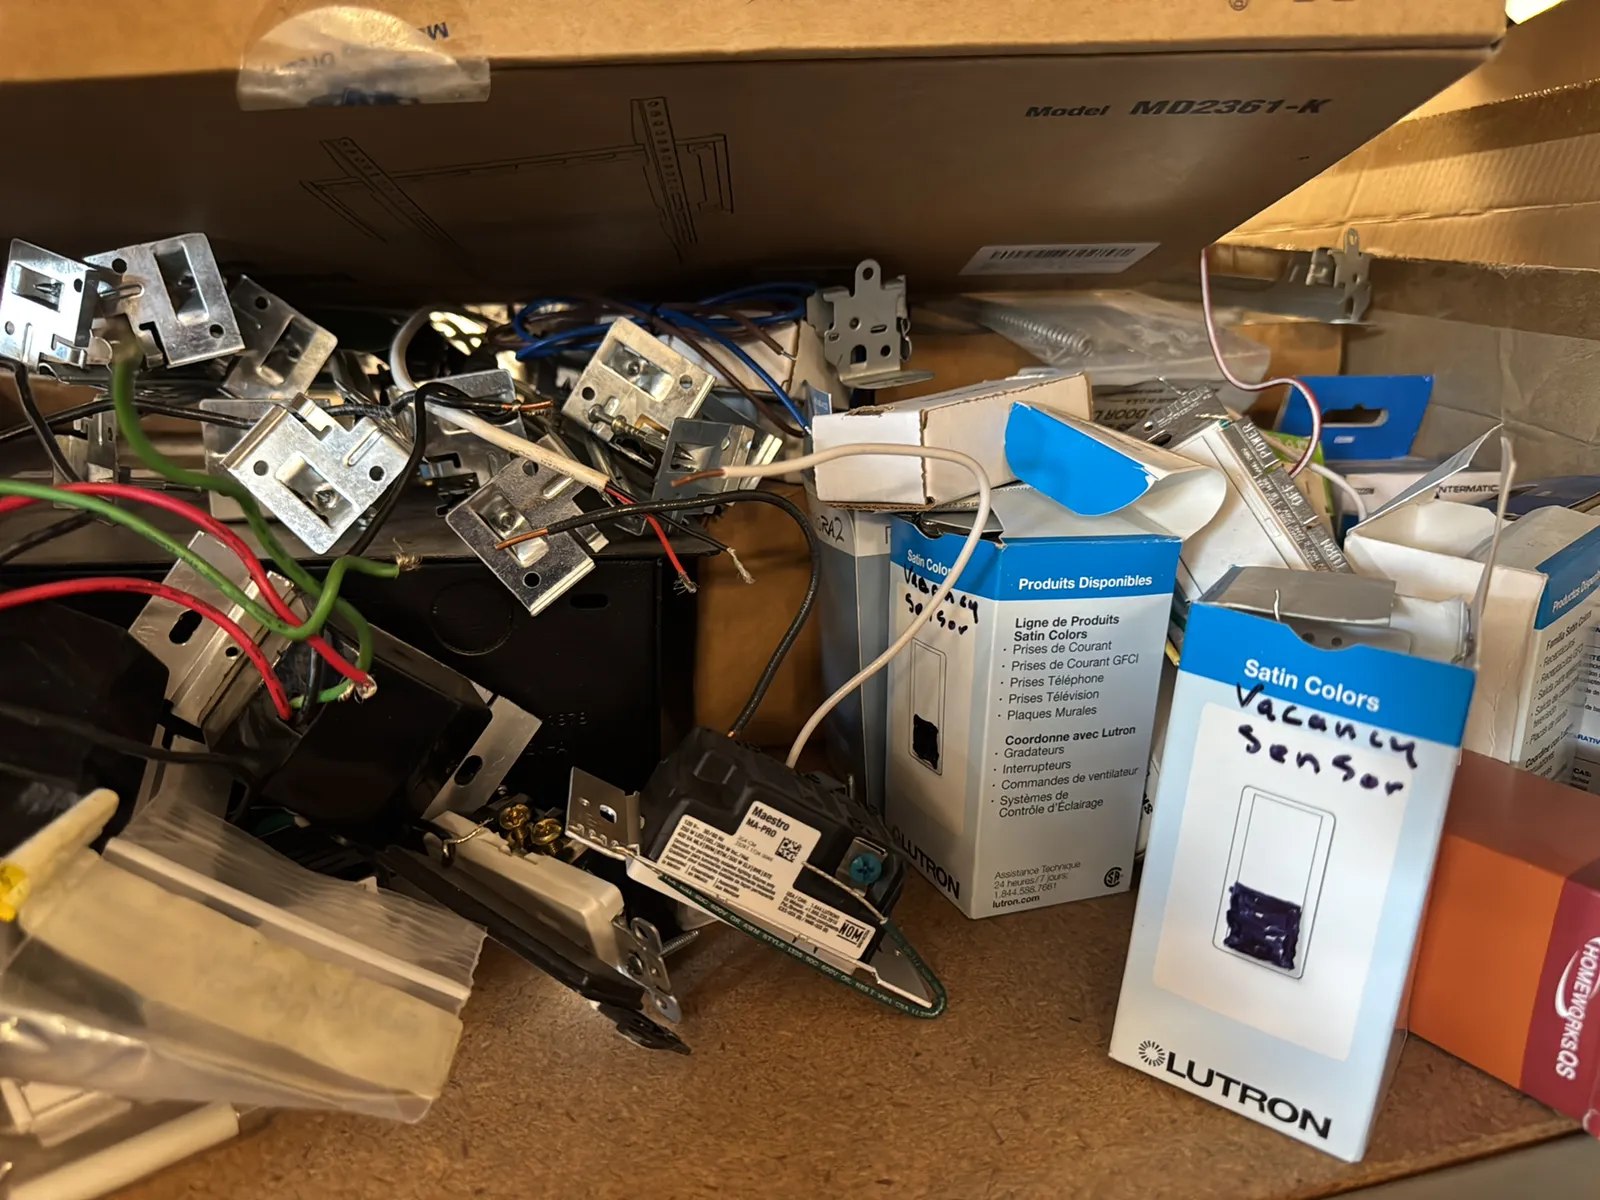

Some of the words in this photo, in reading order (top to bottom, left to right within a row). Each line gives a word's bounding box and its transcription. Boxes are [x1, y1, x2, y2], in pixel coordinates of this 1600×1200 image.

[1025, 105, 1111, 117] Model
[1130, 98, 1335, 115] MD2361-K
[1241, 421, 1272, 460] POWER
[1437, 484, 1500, 494] NTERMATIC
[907, 549, 925, 568] Satin
[926, 558, 953, 576] Colo
[1018, 577, 1075, 591] Produits
[1078, 575, 1153, 590] Disponibles
[1015, 617, 1048, 630] Ligne
[1052, 616, 1067, 627] de
[1071, 614, 1120, 627] Produits
[1014, 630, 1045, 642] Satin
[1048, 628, 1088, 641] Colors
[1013, 644, 1047, 655] Prises
[1051, 643, 1065, 653] de
[1068, 640, 1112, 652] Courant
[1011, 660, 1046, 671] Prises
[1050, 659, 1064, 670] de
[1067, 657, 1110, 669] Courant
[1113, 653, 1139, 665] GFCI
[1010, 676, 1045, 688] Prises
[1048, 672, 1104, 687] Téléphone
[1244, 658, 1298, 690] Satin
[1304, 676, 1380, 712] Colors
[1008, 693, 1043, 704] Prises
[1047, 689, 1100, 702] Télévision
[1007, 709, 1052, 722] Plaques
[1055, 705, 1097, 717] Murales
[1236, 682, 1417, 769] Vacancy
[1005, 732, 1070, 746] Coordonne
[1072, 731, 1099, 741] avec
[1102, 725, 1136, 738] Lutron
[1004, 745, 1065, 758] Gradateurs
[1003, 760, 1072, 774] Interrupteurs
[1001, 776, 1070, 790] Commandes
[1072, 773, 1086, 784] de
[1088, 766, 1139, 781] ventilateur
[1000, 793, 1053, 807] Systèmes
[1055, 790, 1069, 800] de
[752, 806, 790, 831] Maestro
[999, 803, 1045, 818] Contrôle
[746, 818, 777, 838] MA-PRO
[902, 833, 960, 900] LUTRON
[994, 867, 1040, 879] Assistance
[1041, 861, 1081, 873] Technique
[994, 881, 1005, 889] 24
[992, 895, 1040, 908] lutron.com
[839, 921, 863, 943] NOM
[1561, 943, 1600, 1051] HOMEWORKS
[1555, 1049, 1579, 1081] QS
[1165, 1051, 1332, 1141] LUTRON
